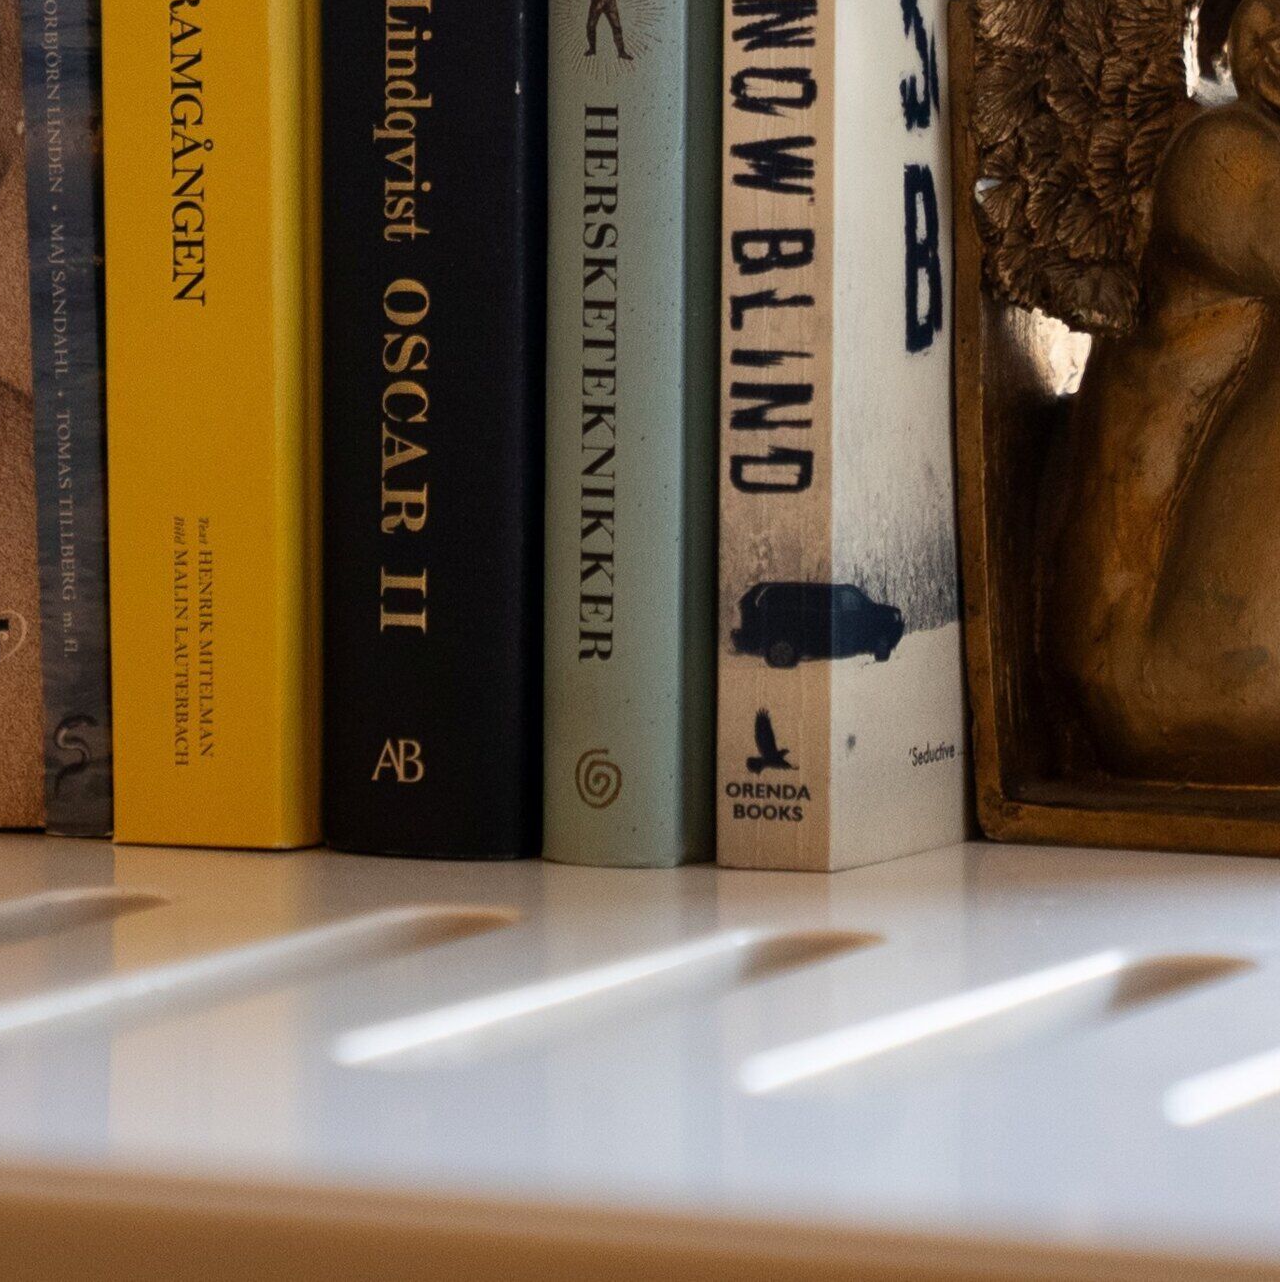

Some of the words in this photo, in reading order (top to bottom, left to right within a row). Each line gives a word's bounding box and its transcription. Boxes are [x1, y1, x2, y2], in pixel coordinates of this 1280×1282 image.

[45, 106, 66, 194] LINDÉN
[46, 222, 67, 267] MAJ
[50, 269, 70, 379] SANDAHL
[379, 277, 431, 536] OSCAR
[578, 102, 621, 664] HERSKETEKNIKKER
[54, 408, 74, 490] TOMAS
[58, 495, 78, 602] TILLBERG
[173, 549, 189, 621] MALIN
[198, 549, 214, 634] HENRIK
[379, 566, 429, 636] II
[174, 626, 190, 767] LAUTERBACH
[198, 638, 215, 758] MITELMAN
[370, 737, 425, 785] AB
[725, 781, 812, 802] ORENDA
[732, 803, 804, 823] BOOKS
